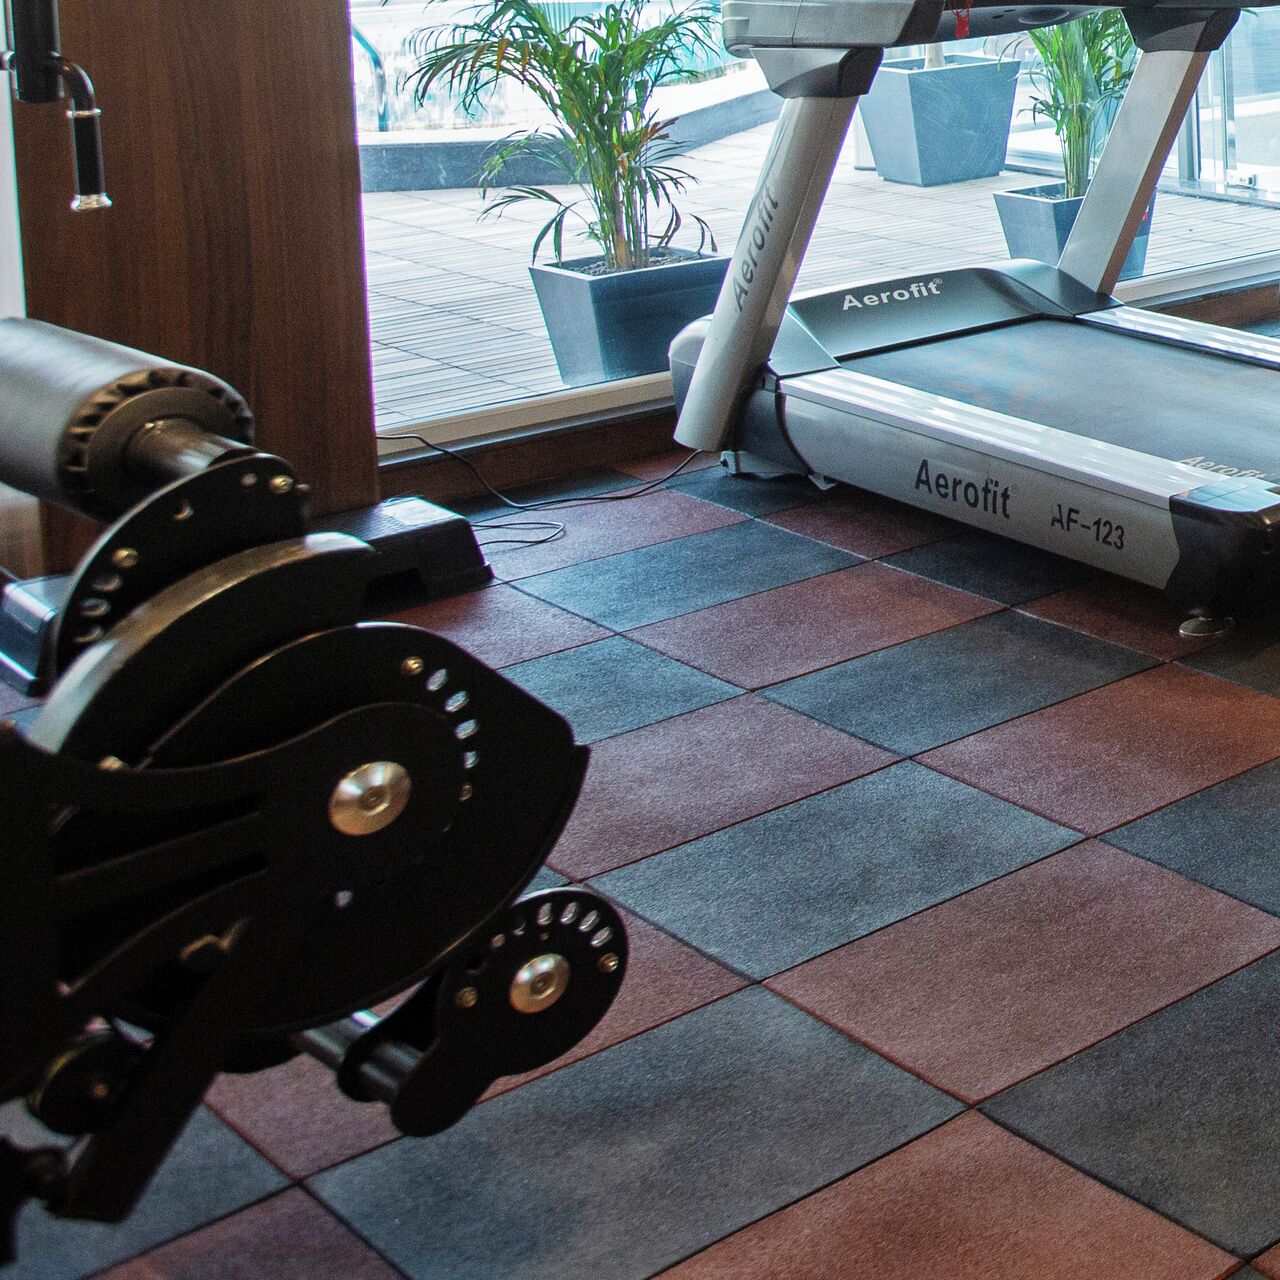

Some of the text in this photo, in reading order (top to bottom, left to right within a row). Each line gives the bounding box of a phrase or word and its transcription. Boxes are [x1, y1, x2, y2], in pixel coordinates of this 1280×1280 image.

[732, 185, 779, 313] Aerofit
[914, 459, 1125, 550] Aerofit AF-123
